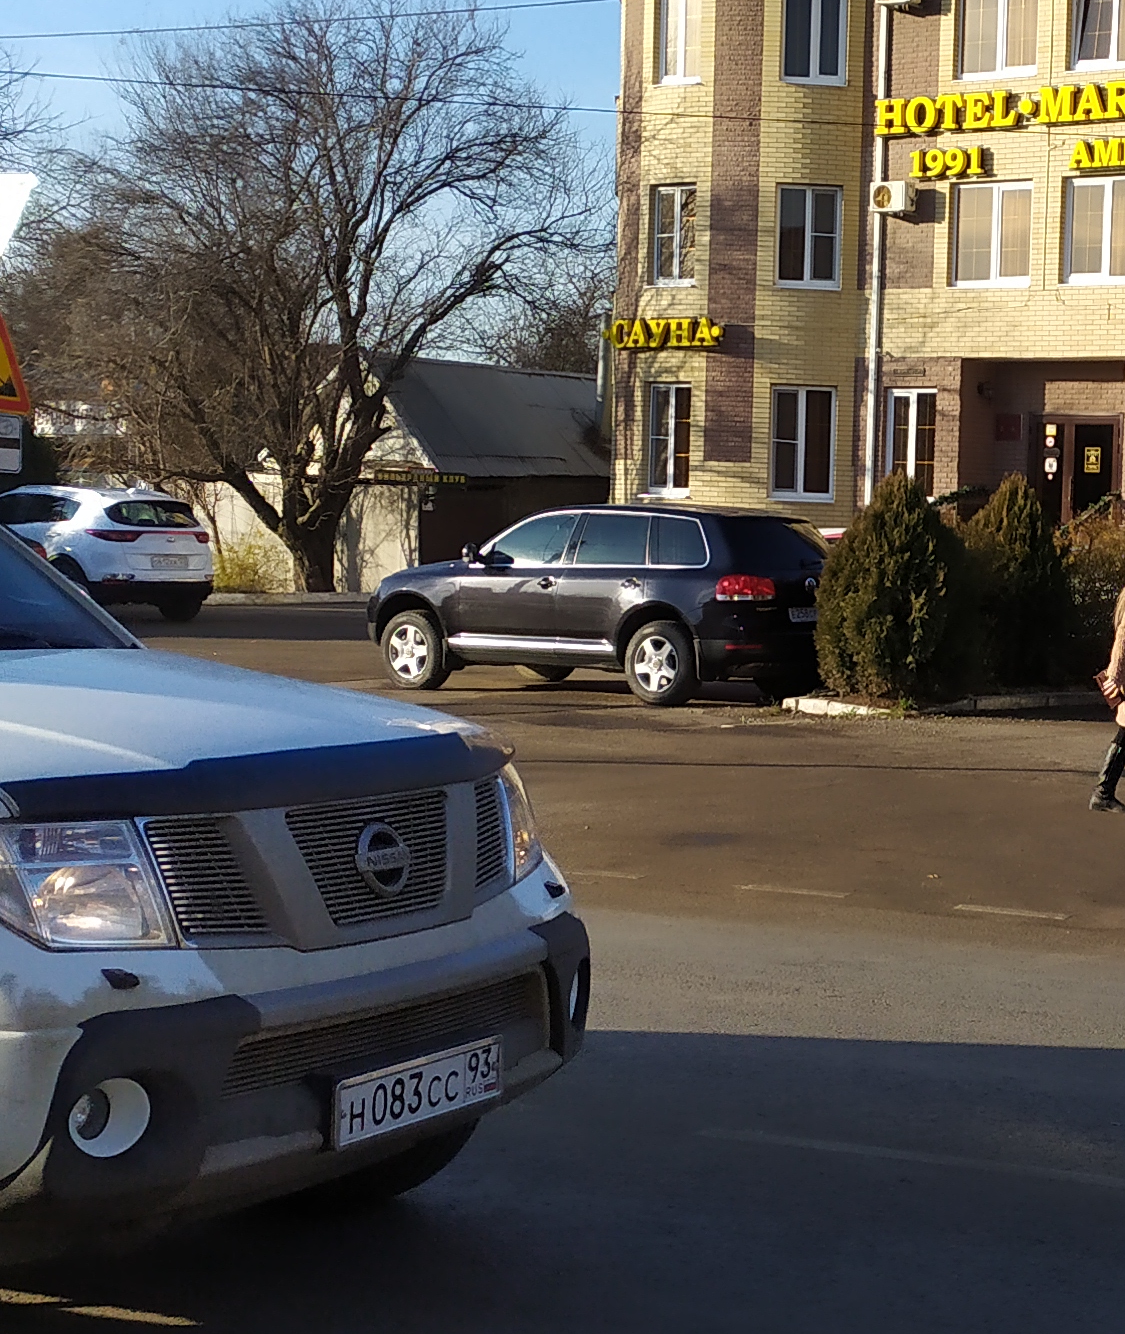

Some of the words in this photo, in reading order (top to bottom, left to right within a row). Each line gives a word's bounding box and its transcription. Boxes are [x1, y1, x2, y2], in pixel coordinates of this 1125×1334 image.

[875, 90, 1020, 136] HOTEL
[909, 145, 985, 178] 1991
[610, 317, 718, 349] САУНА
[442, 474, 466, 484] КЛУБ
[468, 1047, 492, 1084] 93
[466, 1082, 483, 1097] RUS
